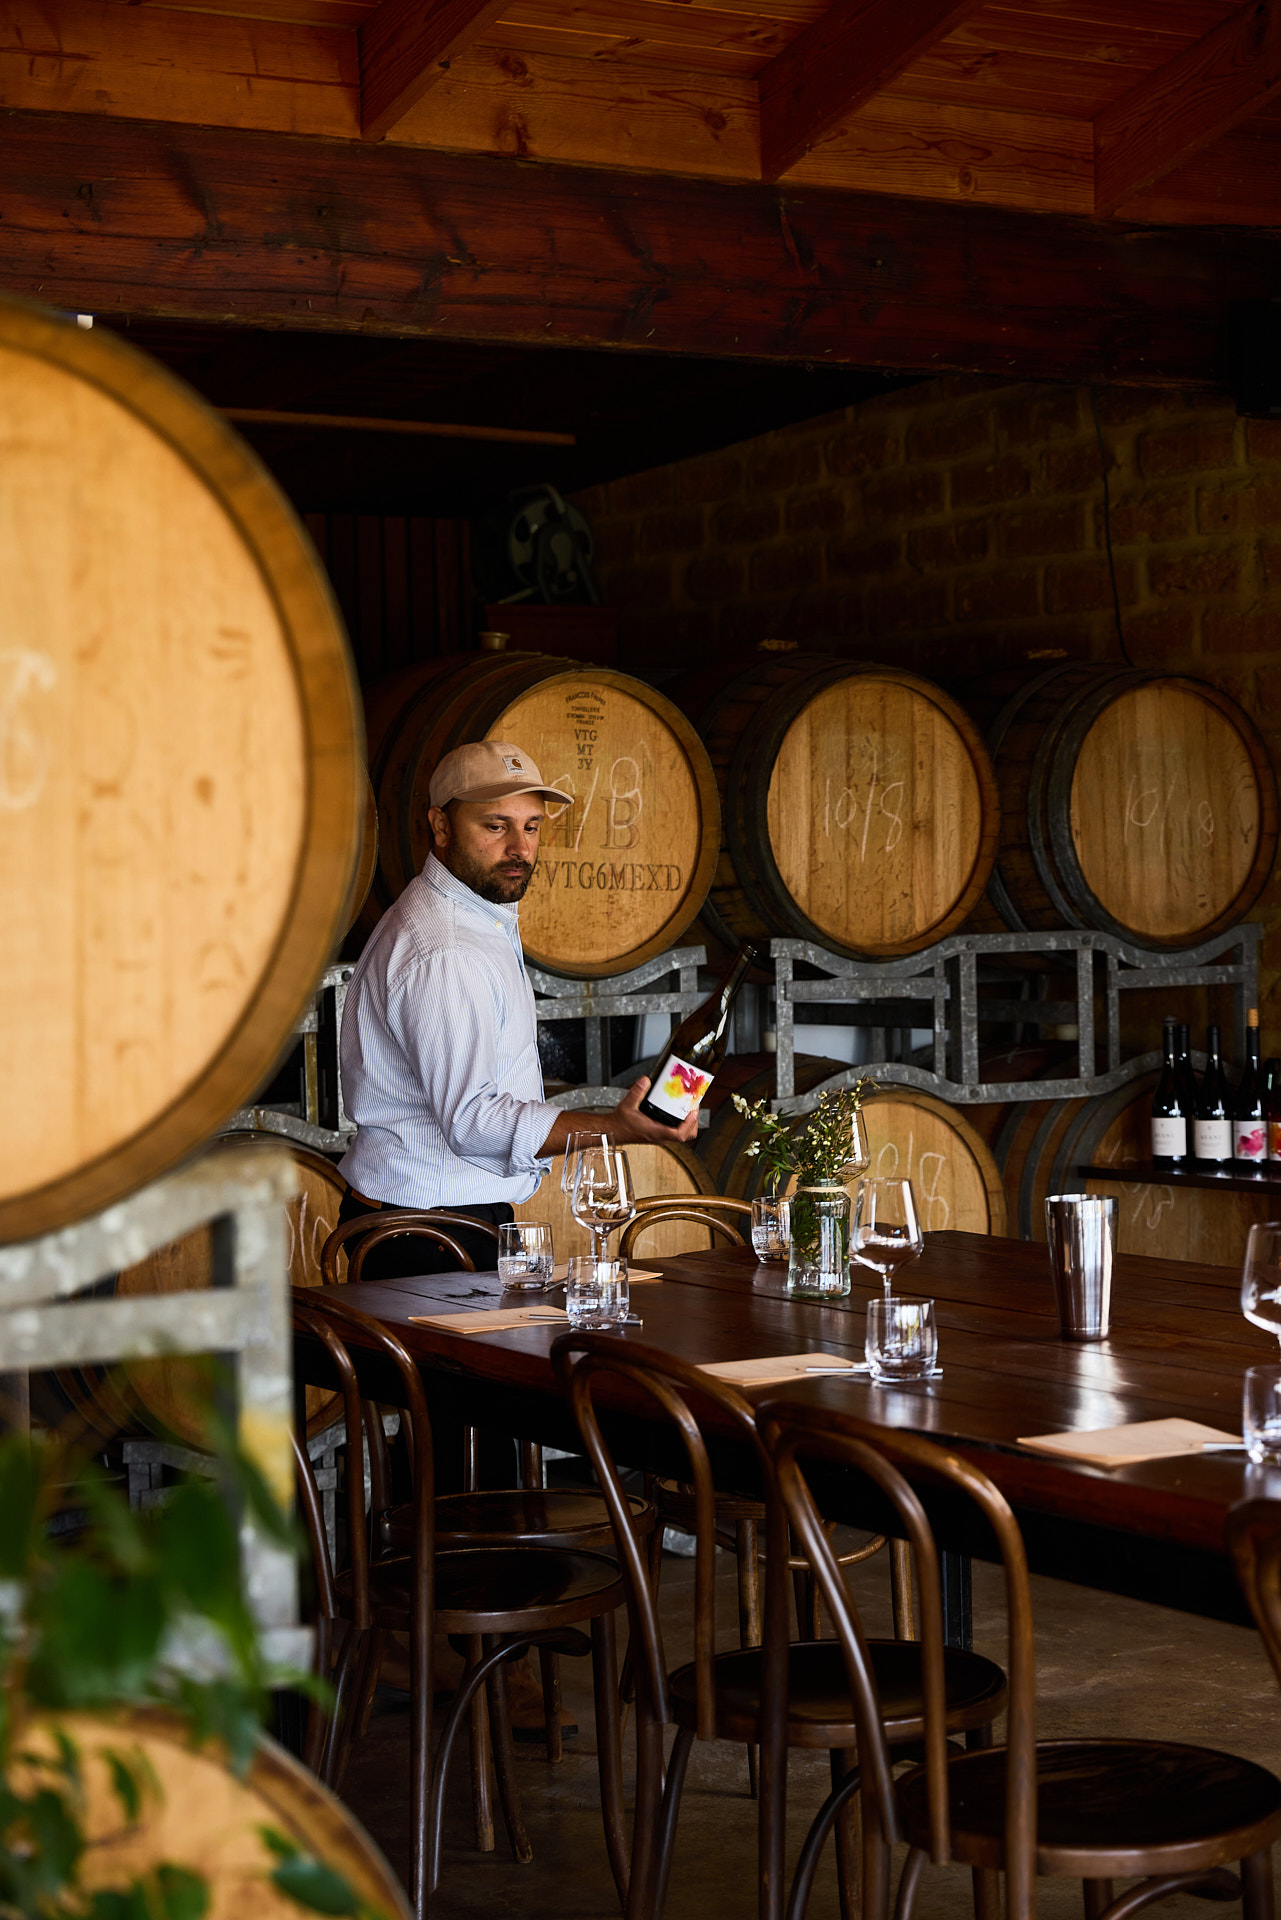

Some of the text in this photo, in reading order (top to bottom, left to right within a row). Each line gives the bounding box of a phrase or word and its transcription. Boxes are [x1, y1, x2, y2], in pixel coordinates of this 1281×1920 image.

[574, 729, 598, 742] VTG
[576, 743, 594, 756] MT
[577, 758, 594, 770] 3Y
